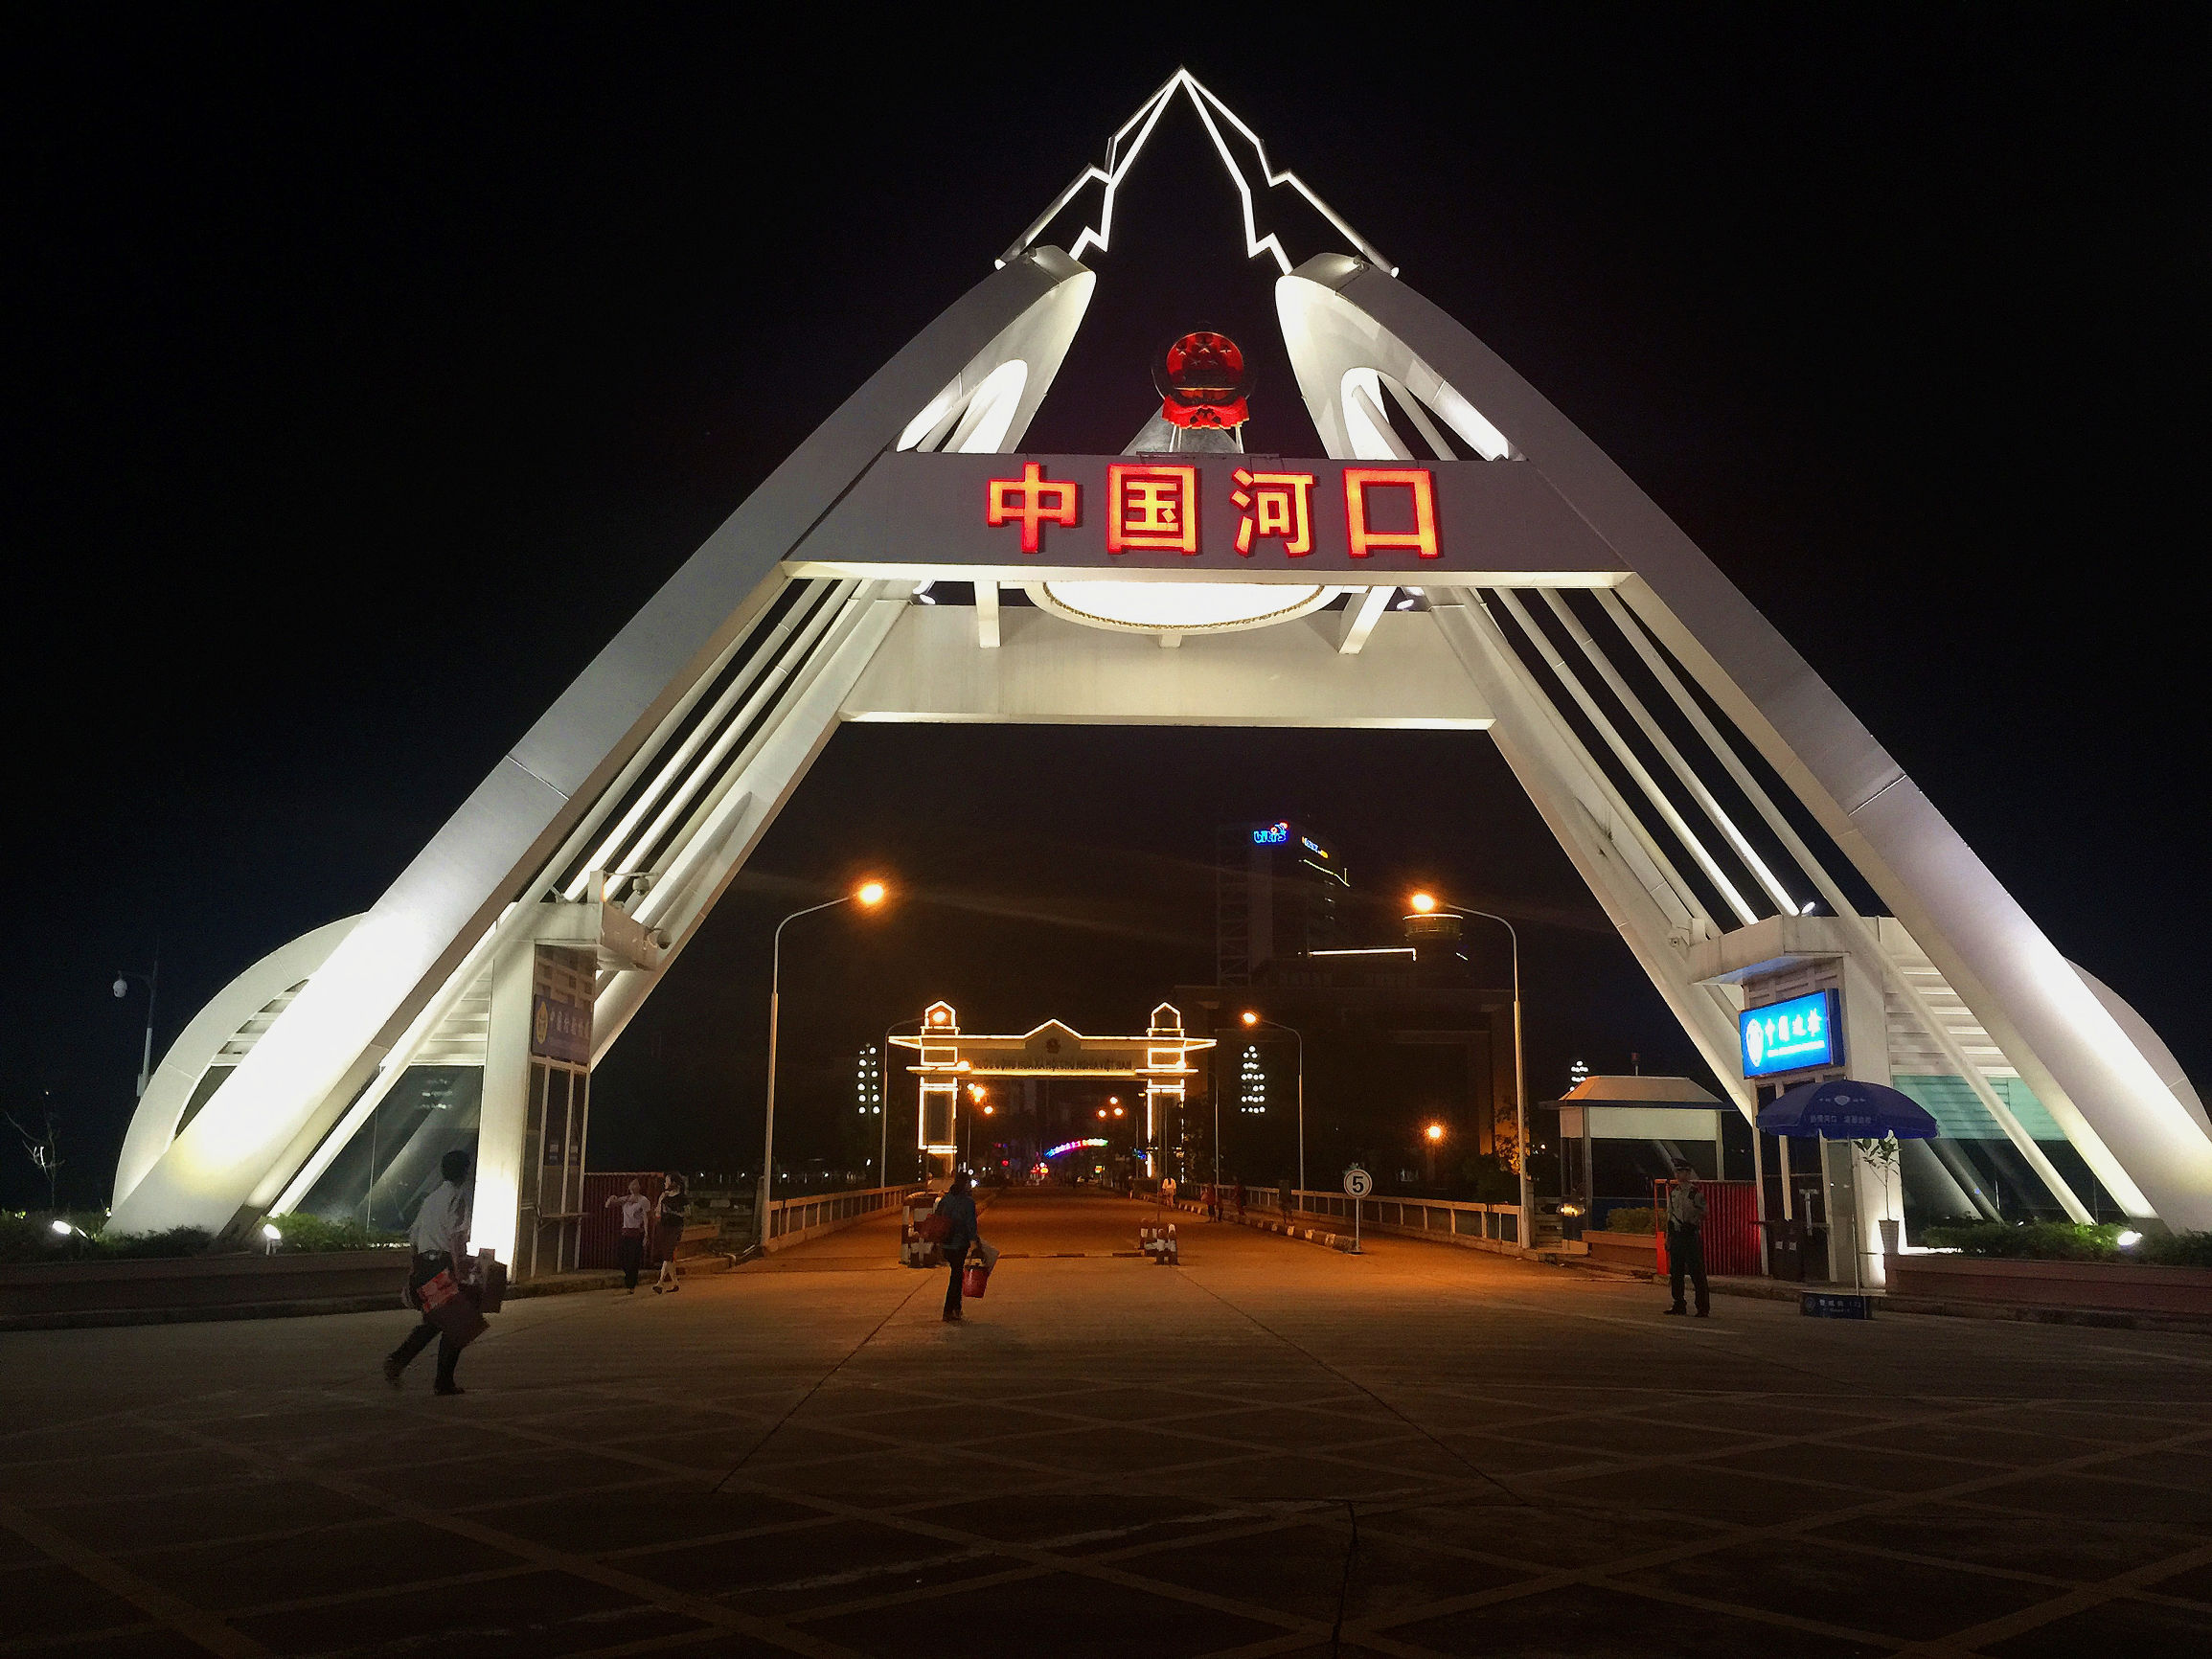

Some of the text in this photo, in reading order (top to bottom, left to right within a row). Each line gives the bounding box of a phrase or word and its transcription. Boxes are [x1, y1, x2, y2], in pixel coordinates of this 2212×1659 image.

[987, 462, 1441, 559] 中国河口
[1352, 1176, 1364, 1193] 5
